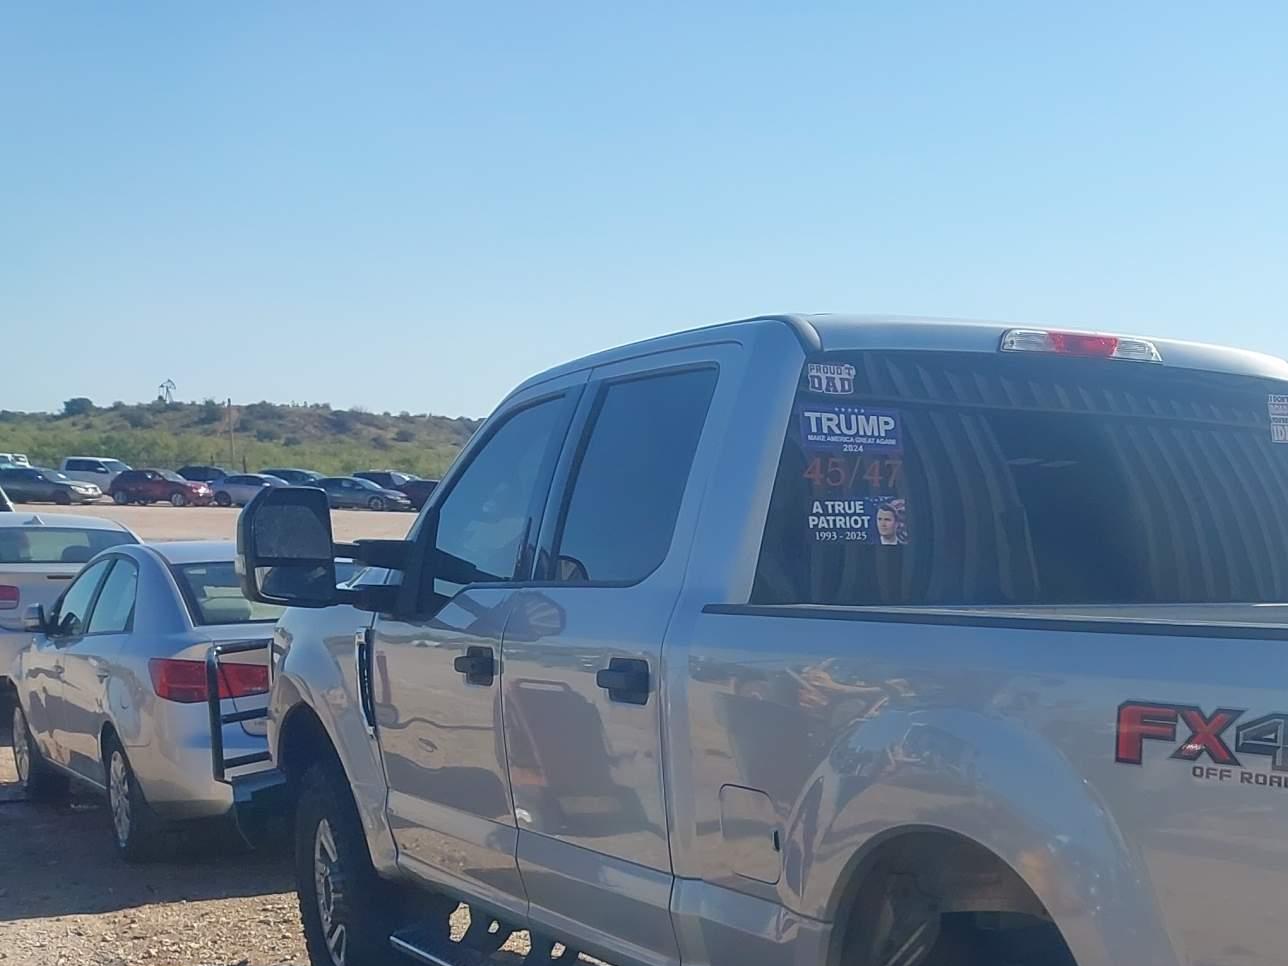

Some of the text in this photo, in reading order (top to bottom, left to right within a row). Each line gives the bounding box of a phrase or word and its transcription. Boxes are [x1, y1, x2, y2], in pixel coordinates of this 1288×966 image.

[809, 364, 843, 376] PROUD
[809, 375, 853, 393] DAD
[804, 411, 895, 437] TRUMP
[843, 444, 864, 452] 2024
[803, 456, 903, 488] 45/47
[812, 501, 864, 513] A TRUE
[808, 516, 871, 529] PATRIOT
[816, 531, 837, 541] 1993
[846, 531, 867, 541] 2025
[1192, 765, 1232, 781] OFF
